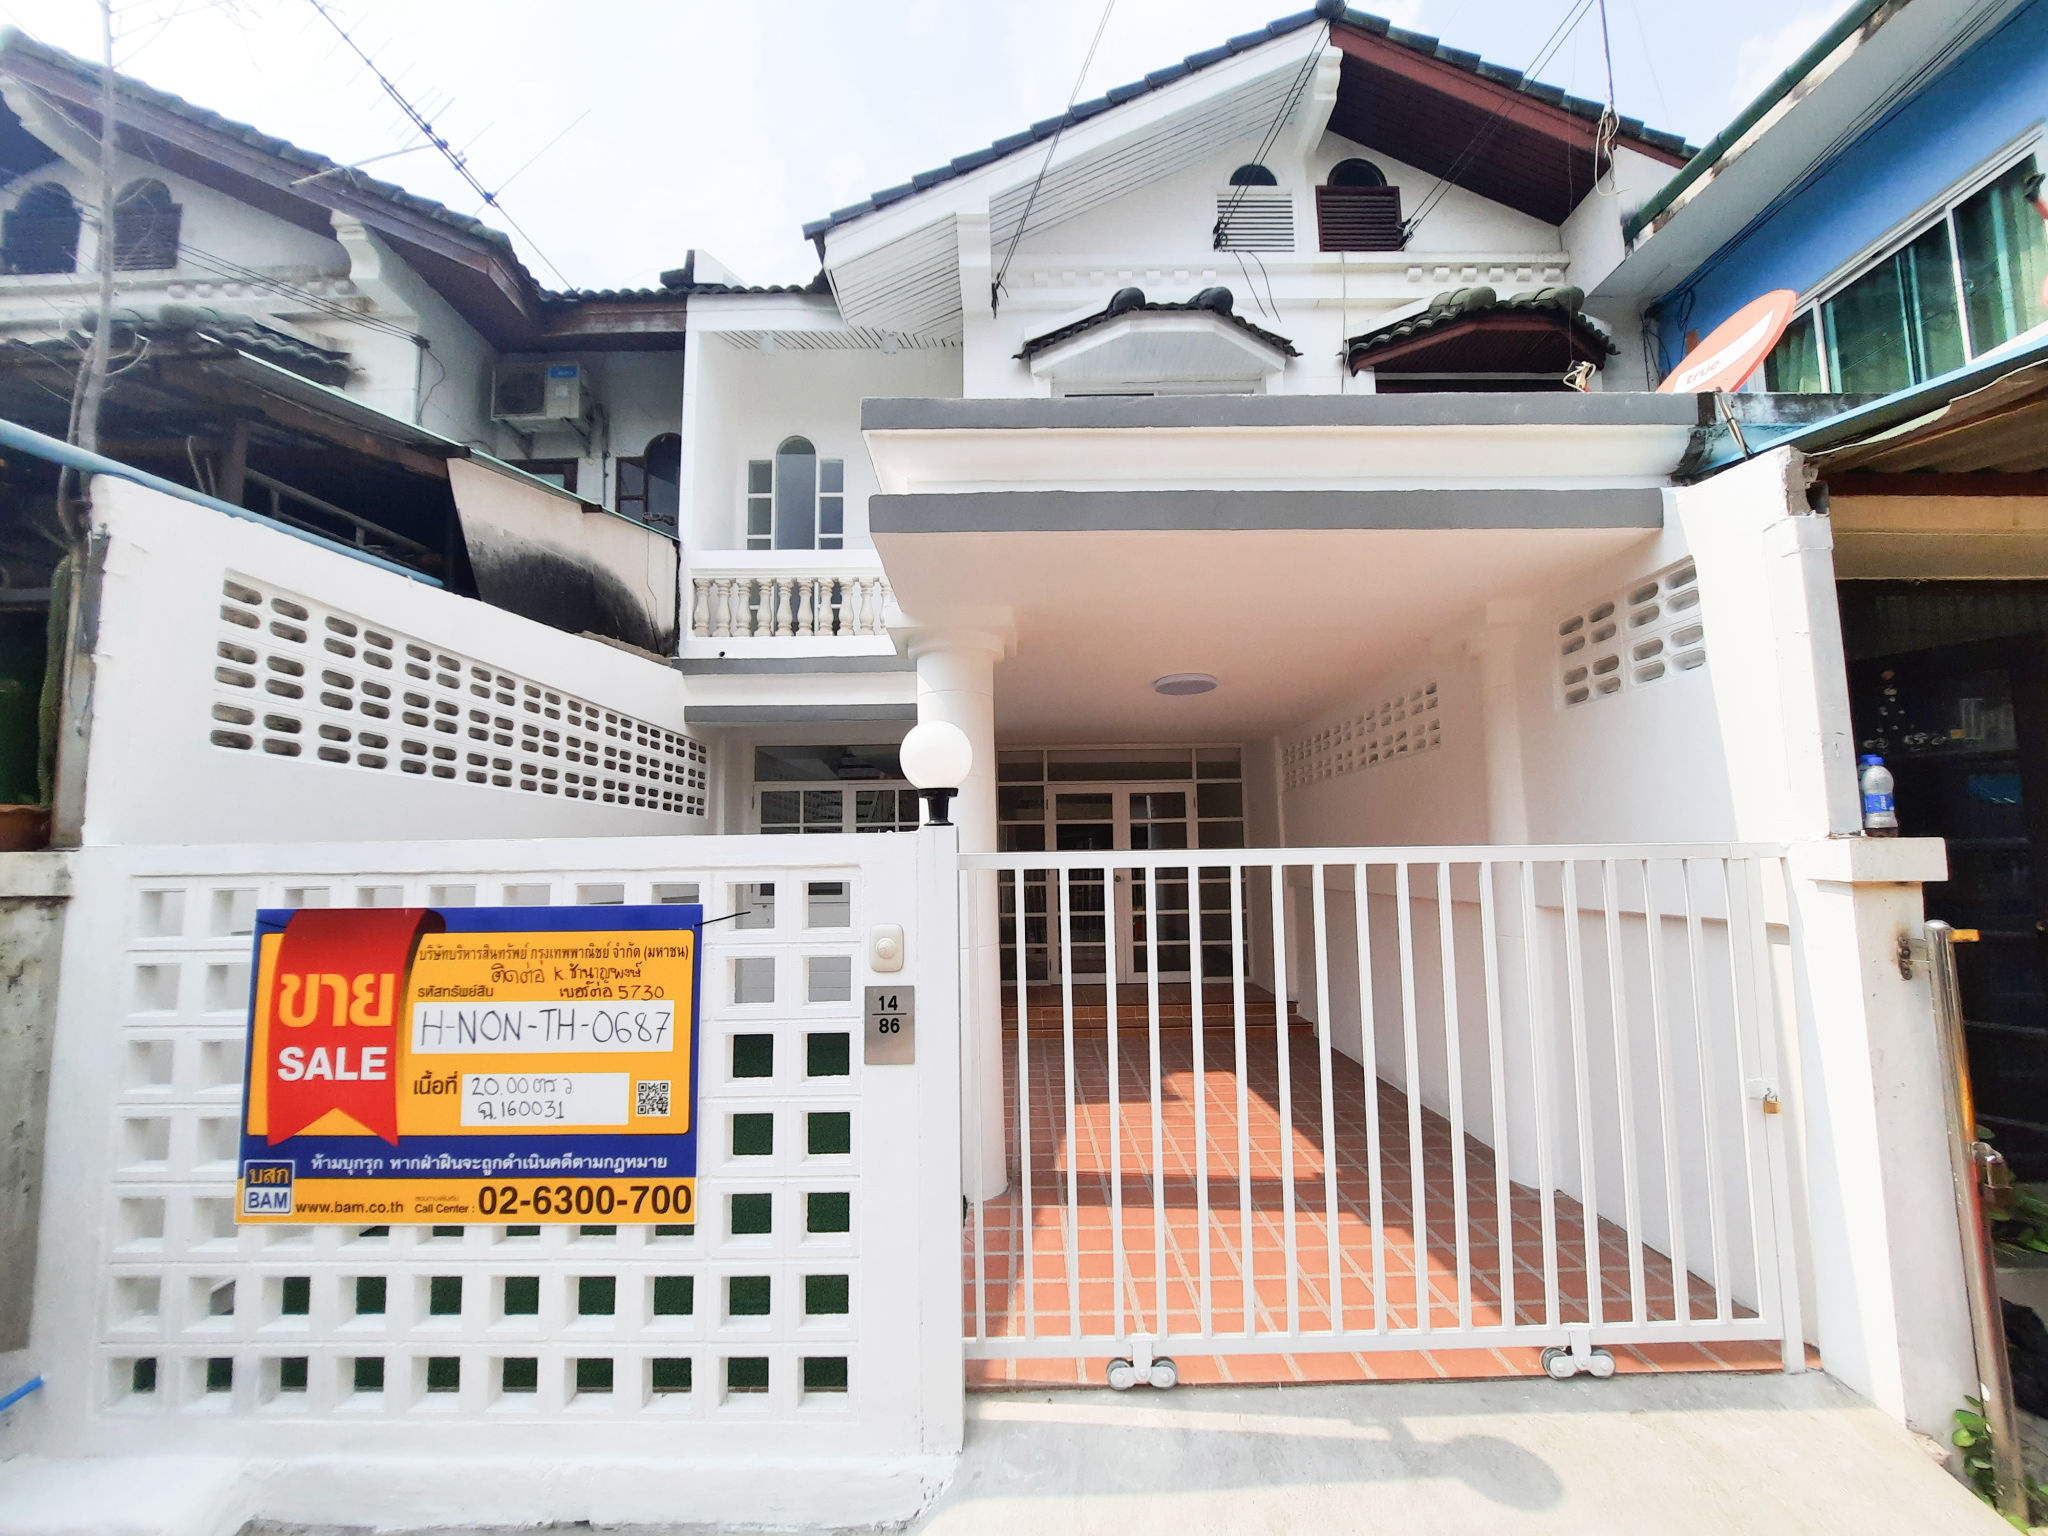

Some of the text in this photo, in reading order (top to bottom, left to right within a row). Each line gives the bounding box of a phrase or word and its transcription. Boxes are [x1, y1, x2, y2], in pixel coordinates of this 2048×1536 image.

[419, 941, 689, 961] บริษัทบริหารสินทรัพย์ กรุงเทพพาณิชย์ จำกัด (มหาชน)
[491, 961, 545, 984] ติดต่อ
[278, 973, 395, 1028] ขาย
[417, 985, 494, 998] รหัสทรัพย์สิน
[618, 984, 665, 1001] 5730
[878, 995, 898, 1011] 14
[421, 1008, 671, 1046] H-NON-TH-0687
[878, 1018, 900, 1034] 86
[277, 1046, 388, 1081] SALE
[413, 1070, 458, 1095] เนื้อที่
[311, 1152, 668, 1176] ห้ามบุกรุก หากฝ่าฝืนจะถูกดำเนินคดีตามกฎหมาย
[249, 1167, 289, 1185] บสก
[249, 1191, 288, 1209] BAM
[296, 1201, 404, 1214] www.bam.co.th
[414, 1203, 434, 1214] Call
[436, 1203, 468, 1214] Center
[478, 1184, 692, 1215] 02-6300-700
